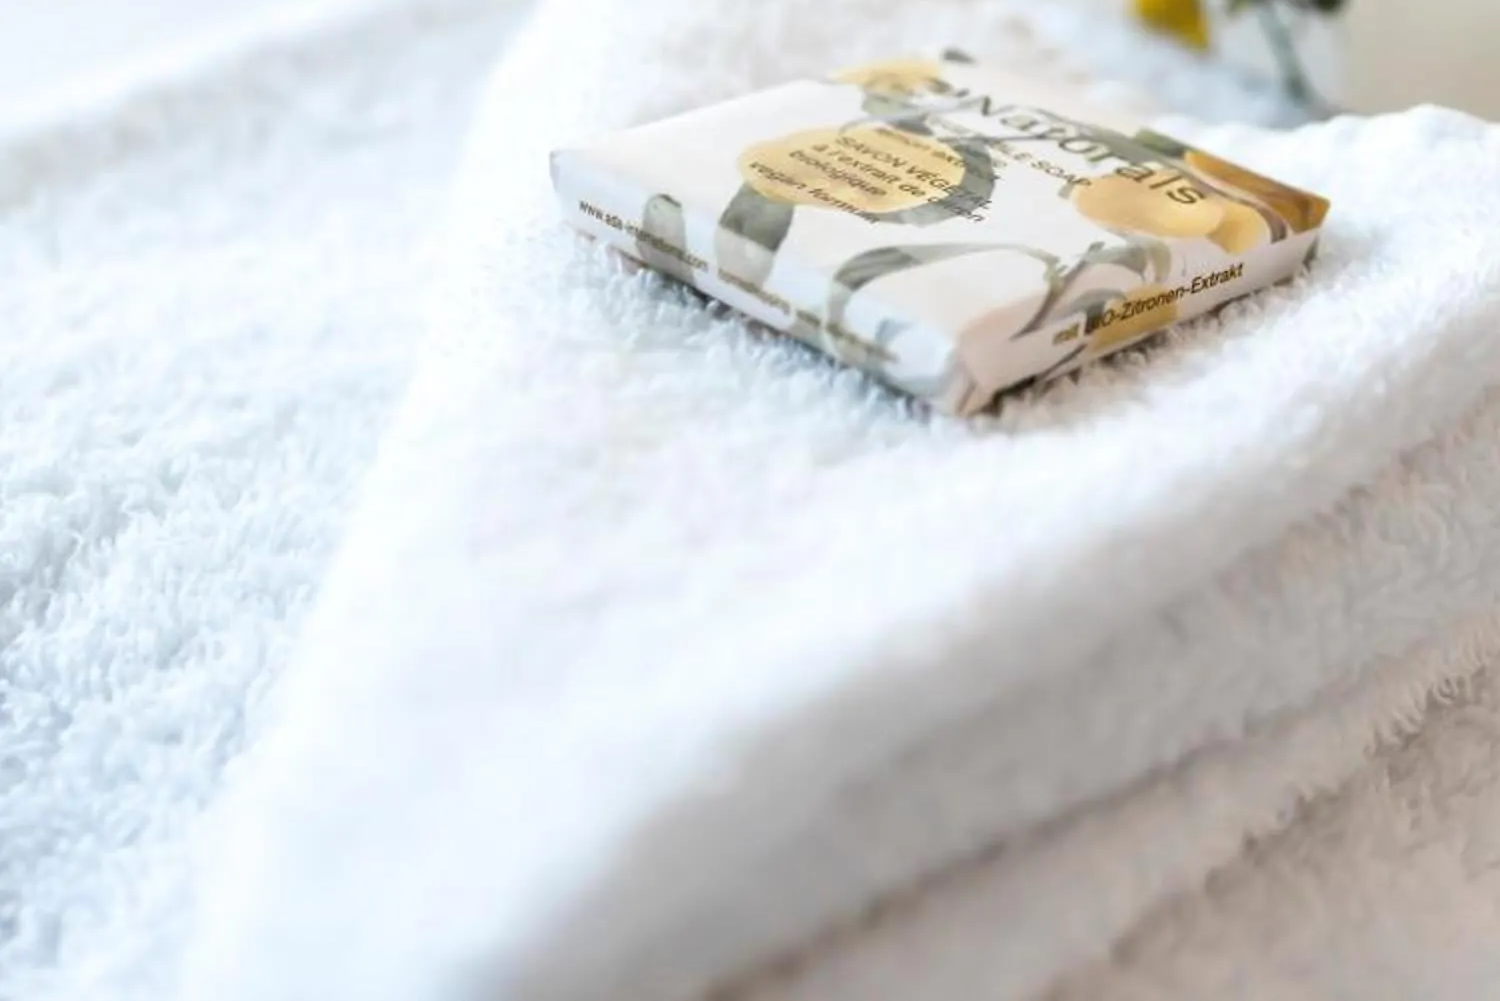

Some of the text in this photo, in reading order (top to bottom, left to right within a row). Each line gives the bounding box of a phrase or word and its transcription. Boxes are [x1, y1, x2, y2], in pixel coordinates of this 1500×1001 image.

[836, 136, 908, 169] SAVON
[749, 161, 807, 190] vegan
[788, 149, 888, 197] biologique
[1031, 158, 1092, 187] SOAP
[897, 182, 926, 197] de
